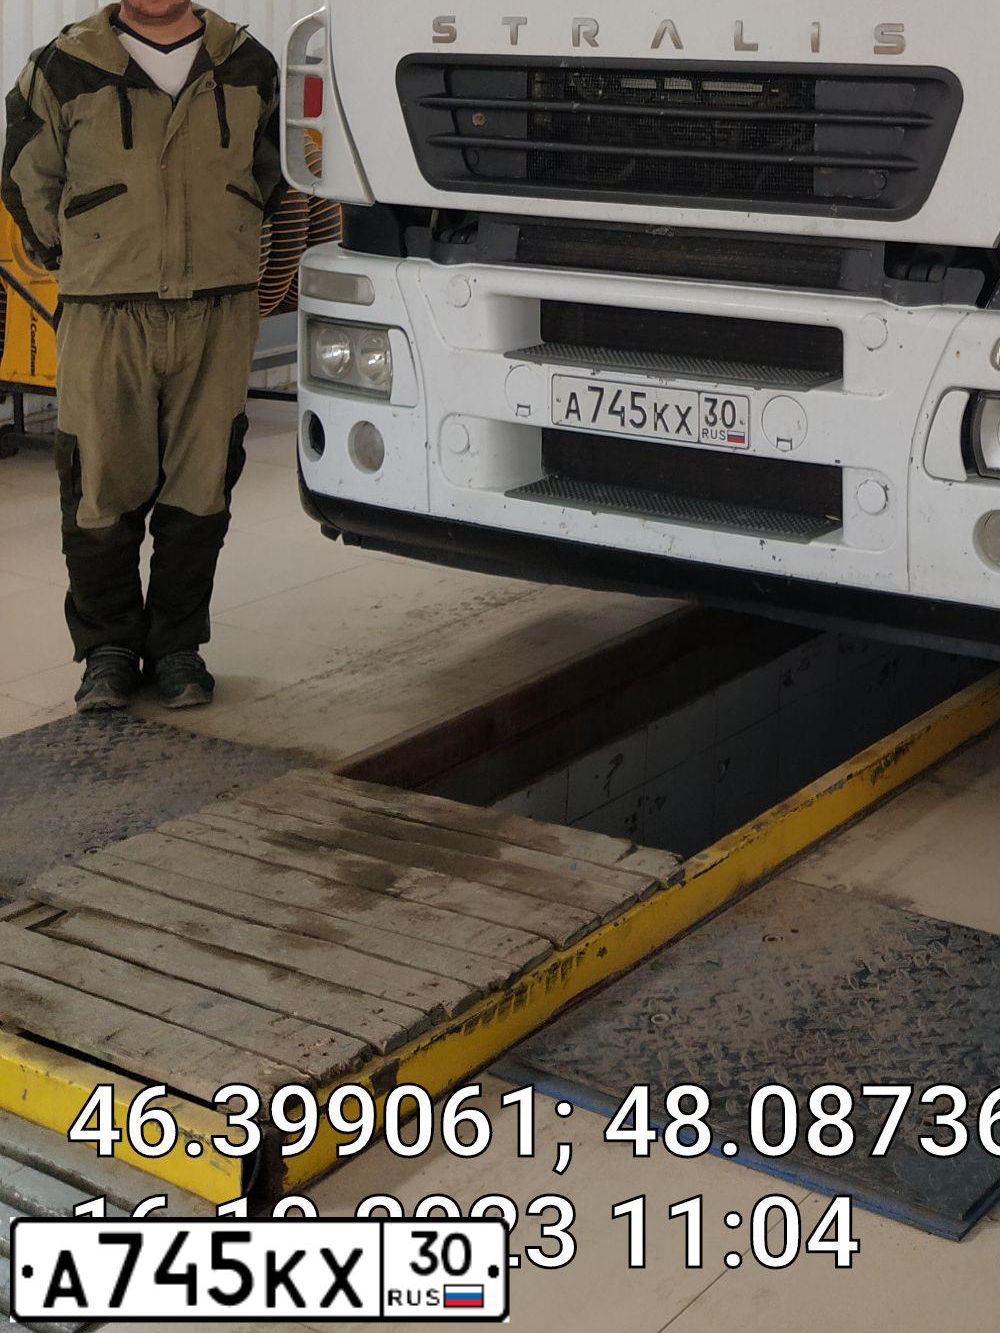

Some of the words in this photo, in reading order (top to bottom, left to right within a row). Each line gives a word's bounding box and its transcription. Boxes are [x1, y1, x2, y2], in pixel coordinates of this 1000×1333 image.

[431, 15, 907, 55] STRALIS
[704, 397, 737, 429] 30
[701, 428, 726, 441] RUS
